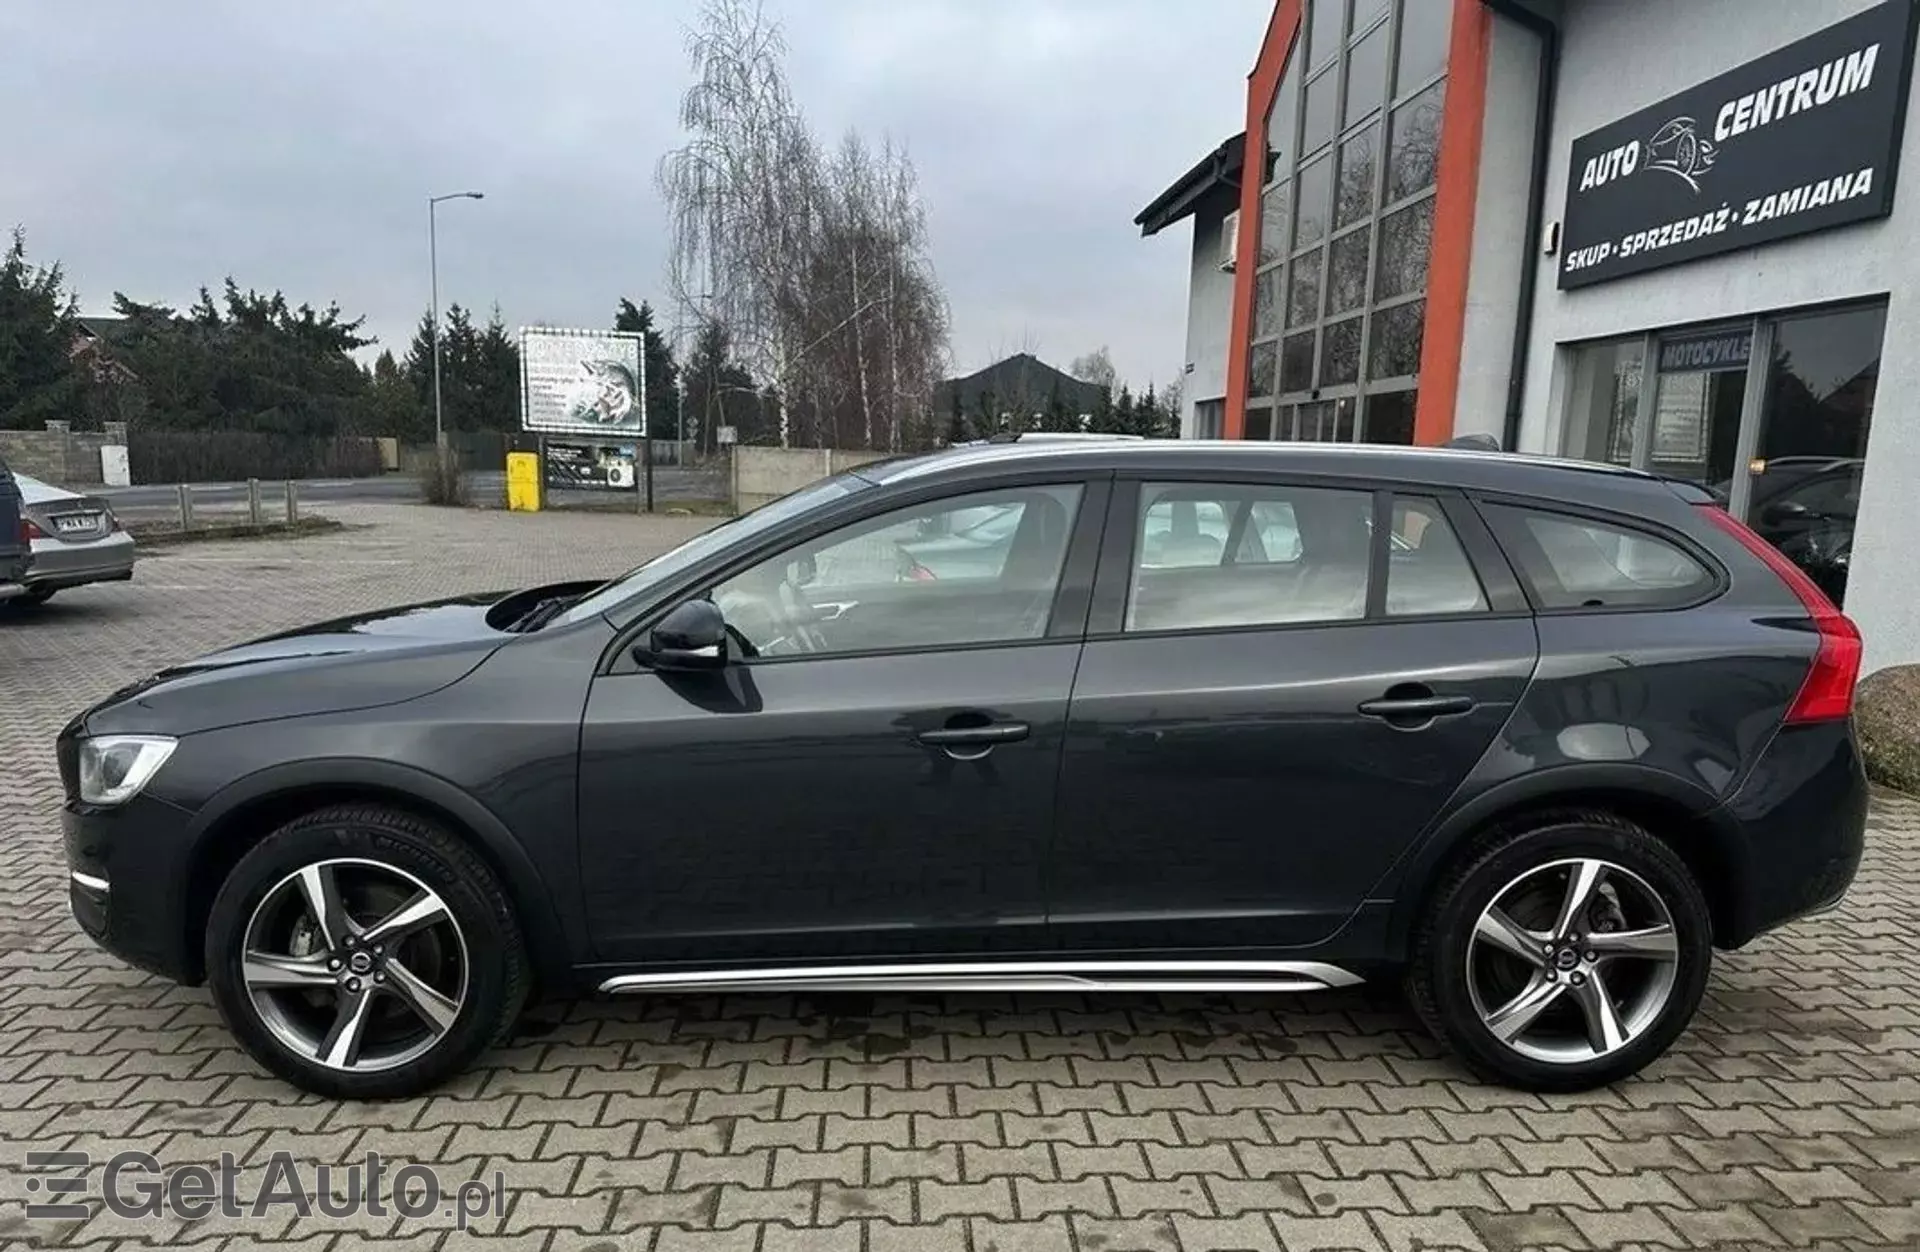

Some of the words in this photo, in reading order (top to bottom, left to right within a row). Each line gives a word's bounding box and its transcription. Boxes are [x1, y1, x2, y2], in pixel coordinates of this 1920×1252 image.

[1579, 140, 1640, 192] AUTO
[1714, 44, 1880, 142] CENTRUM
[1566, 243, 1611, 272] SKUP
[1619, 203, 1730, 258] SPRZEDAŻ
[1742, 168, 1874, 224] ZAMIANA
[1662, 336, 1750, 369] MOTOCYKLE
